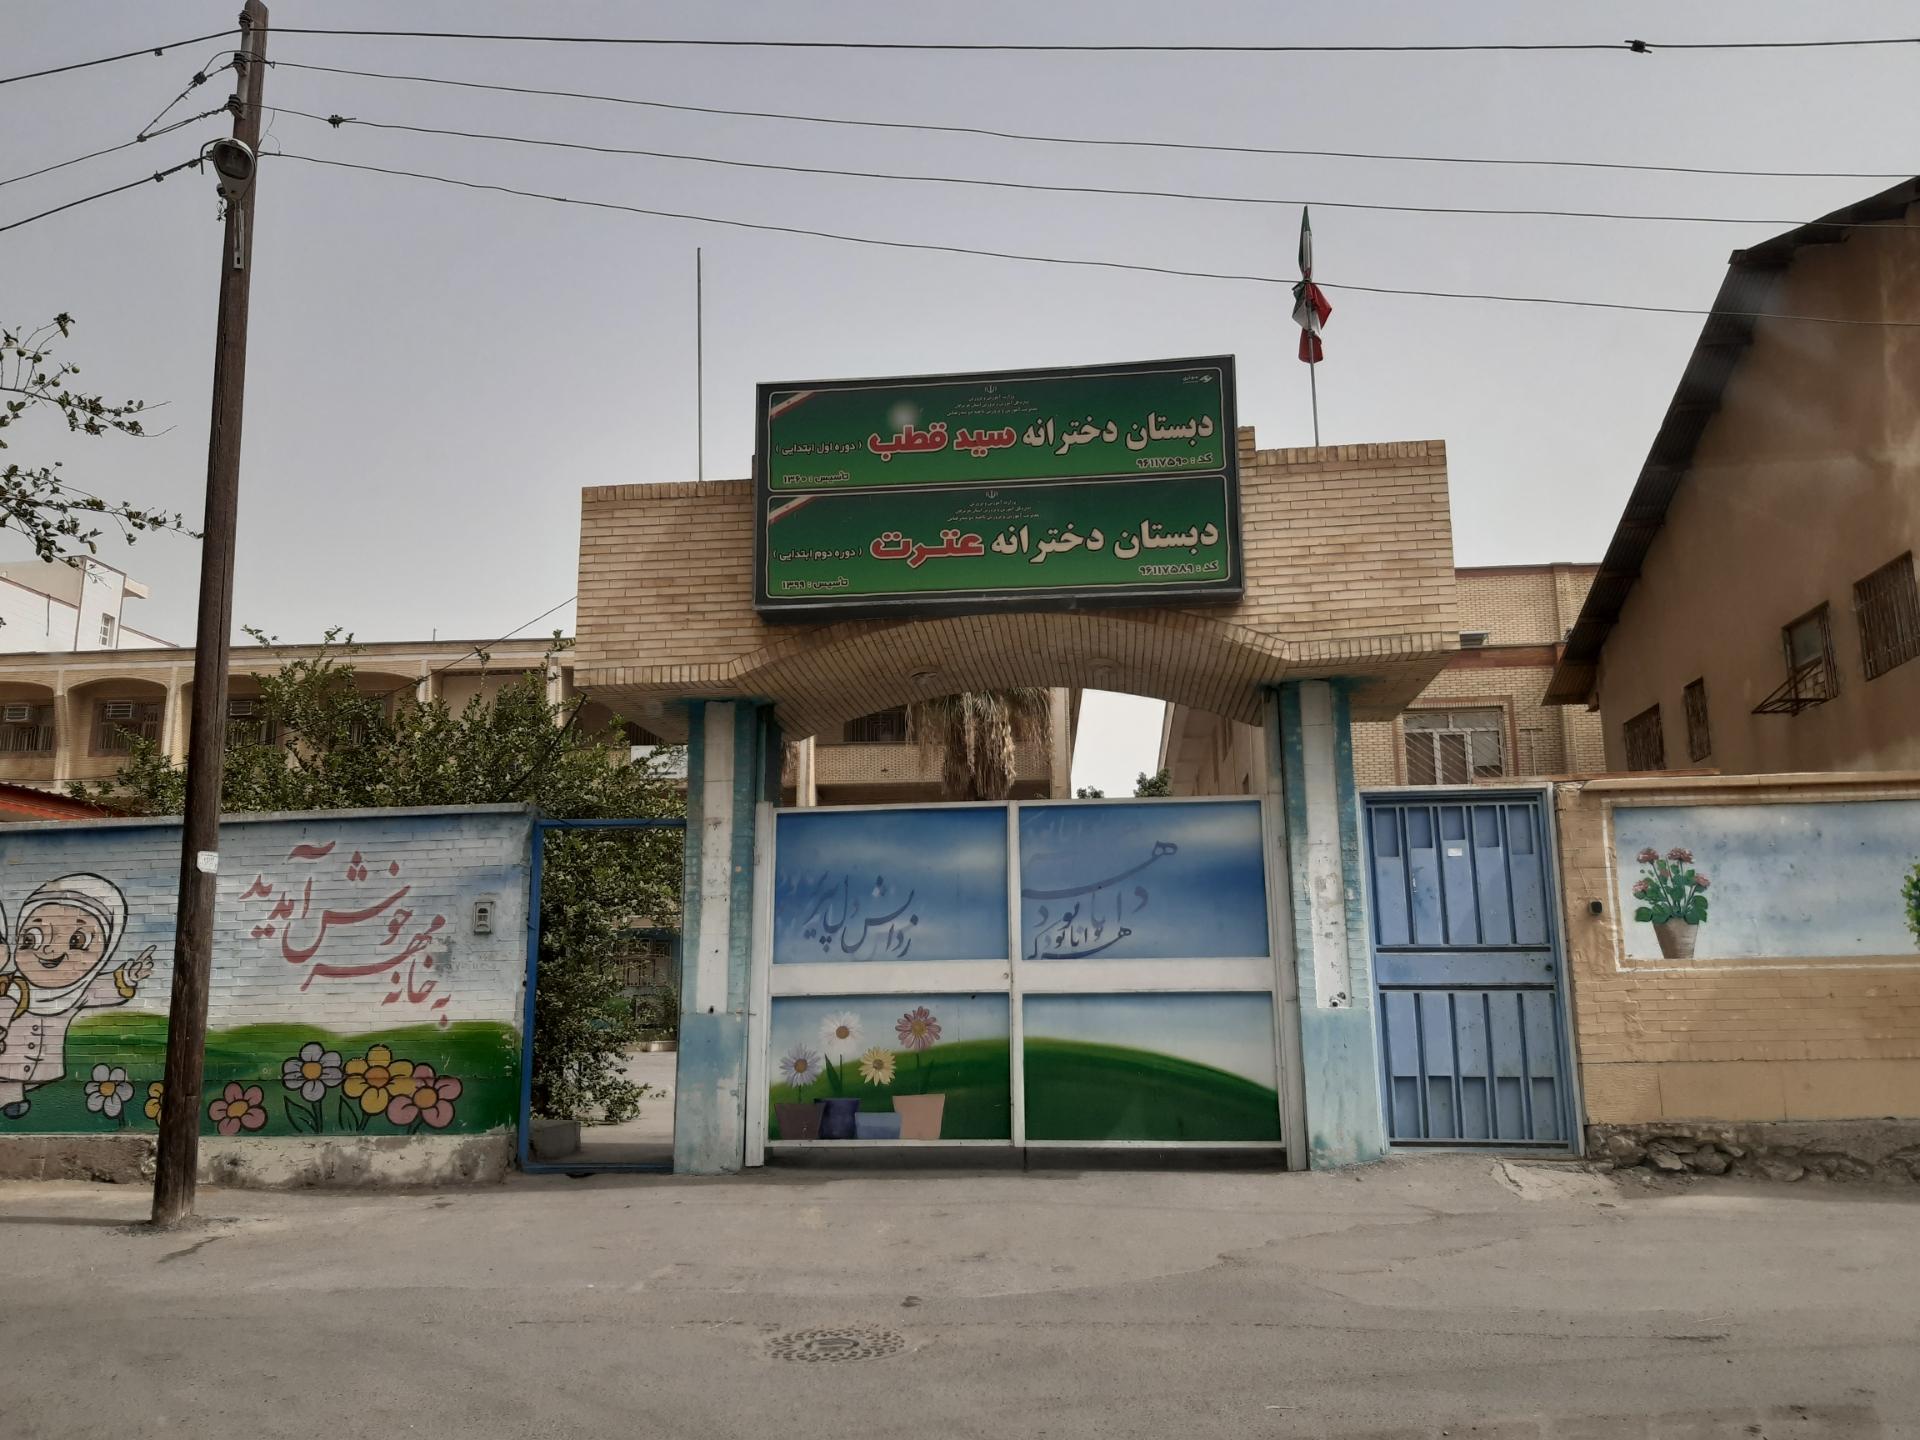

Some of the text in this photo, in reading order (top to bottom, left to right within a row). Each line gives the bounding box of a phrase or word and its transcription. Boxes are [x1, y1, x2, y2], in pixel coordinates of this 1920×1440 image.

[817, 442, 833, 454] اول
[867, 421, 949, 462] قطب
[953, 426, 1017, 458] سید
[1021, 416, 1119, 456] دخترانه
[1125, 411, 1214, 452] دبستان
[814, 549, 832, 560] دوم
[870, 529, 985, 569] عترت
[990, 525, 1105, 565] دخترانه
[1114, 519, 1219, 560] دبستان
[239, 840, 451, 1027] به خانه مهر خوش آمدید
